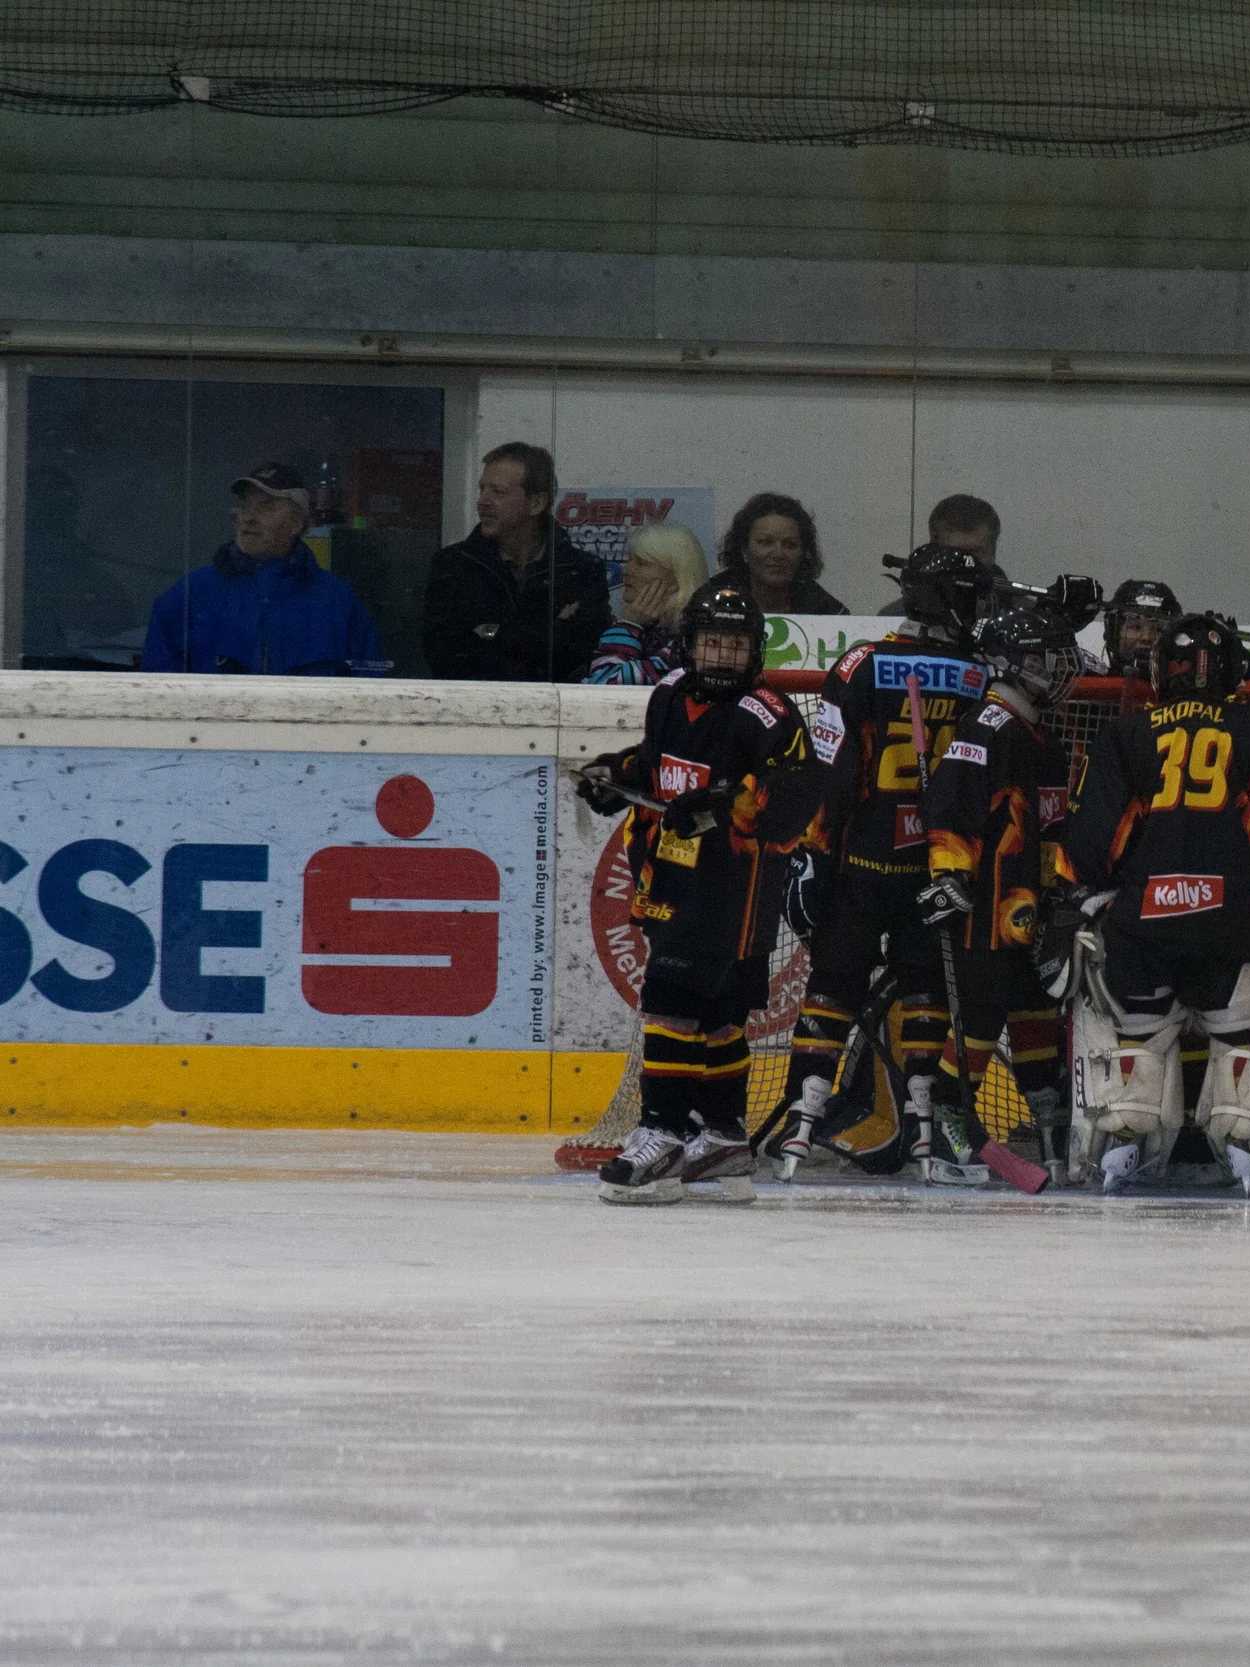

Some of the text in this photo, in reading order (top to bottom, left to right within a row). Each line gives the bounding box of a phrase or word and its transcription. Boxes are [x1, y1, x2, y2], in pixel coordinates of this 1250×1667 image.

[554, 492, 675, 526] ÖEHV
[877, 660, 960, 689] ERSTE
[740, 695, 776, 727] RICOH
[1151, 701, 1225, 729] SKOPAL
[1151, 726, 1235, 813] 39
[1154, 880, 1213, 908] Kelly's
[0, 838, 269, 1014] SE
[530, 959, 547, 981] by:
[529, 987, 545, 1043] printed
